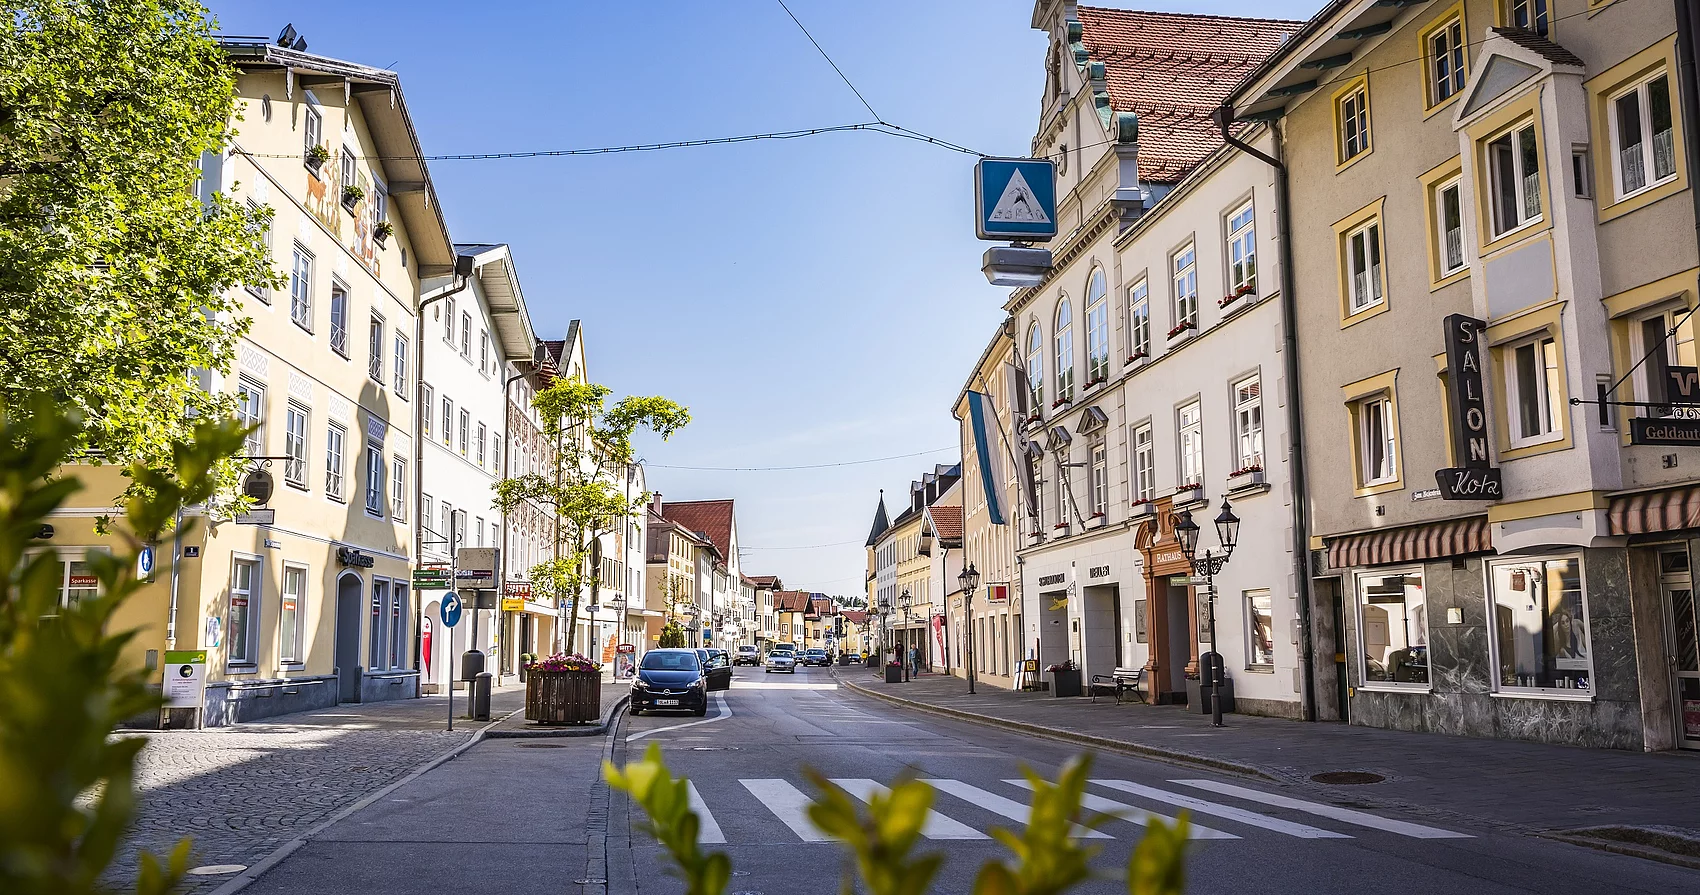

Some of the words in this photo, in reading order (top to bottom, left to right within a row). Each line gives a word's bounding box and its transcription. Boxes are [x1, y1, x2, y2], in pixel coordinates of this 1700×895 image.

[1460, 321, 1486, 461] SALON
[1646, 426, 1700, 440] Geldaut
[1156, 551, 1182, 563] RATHAUS
